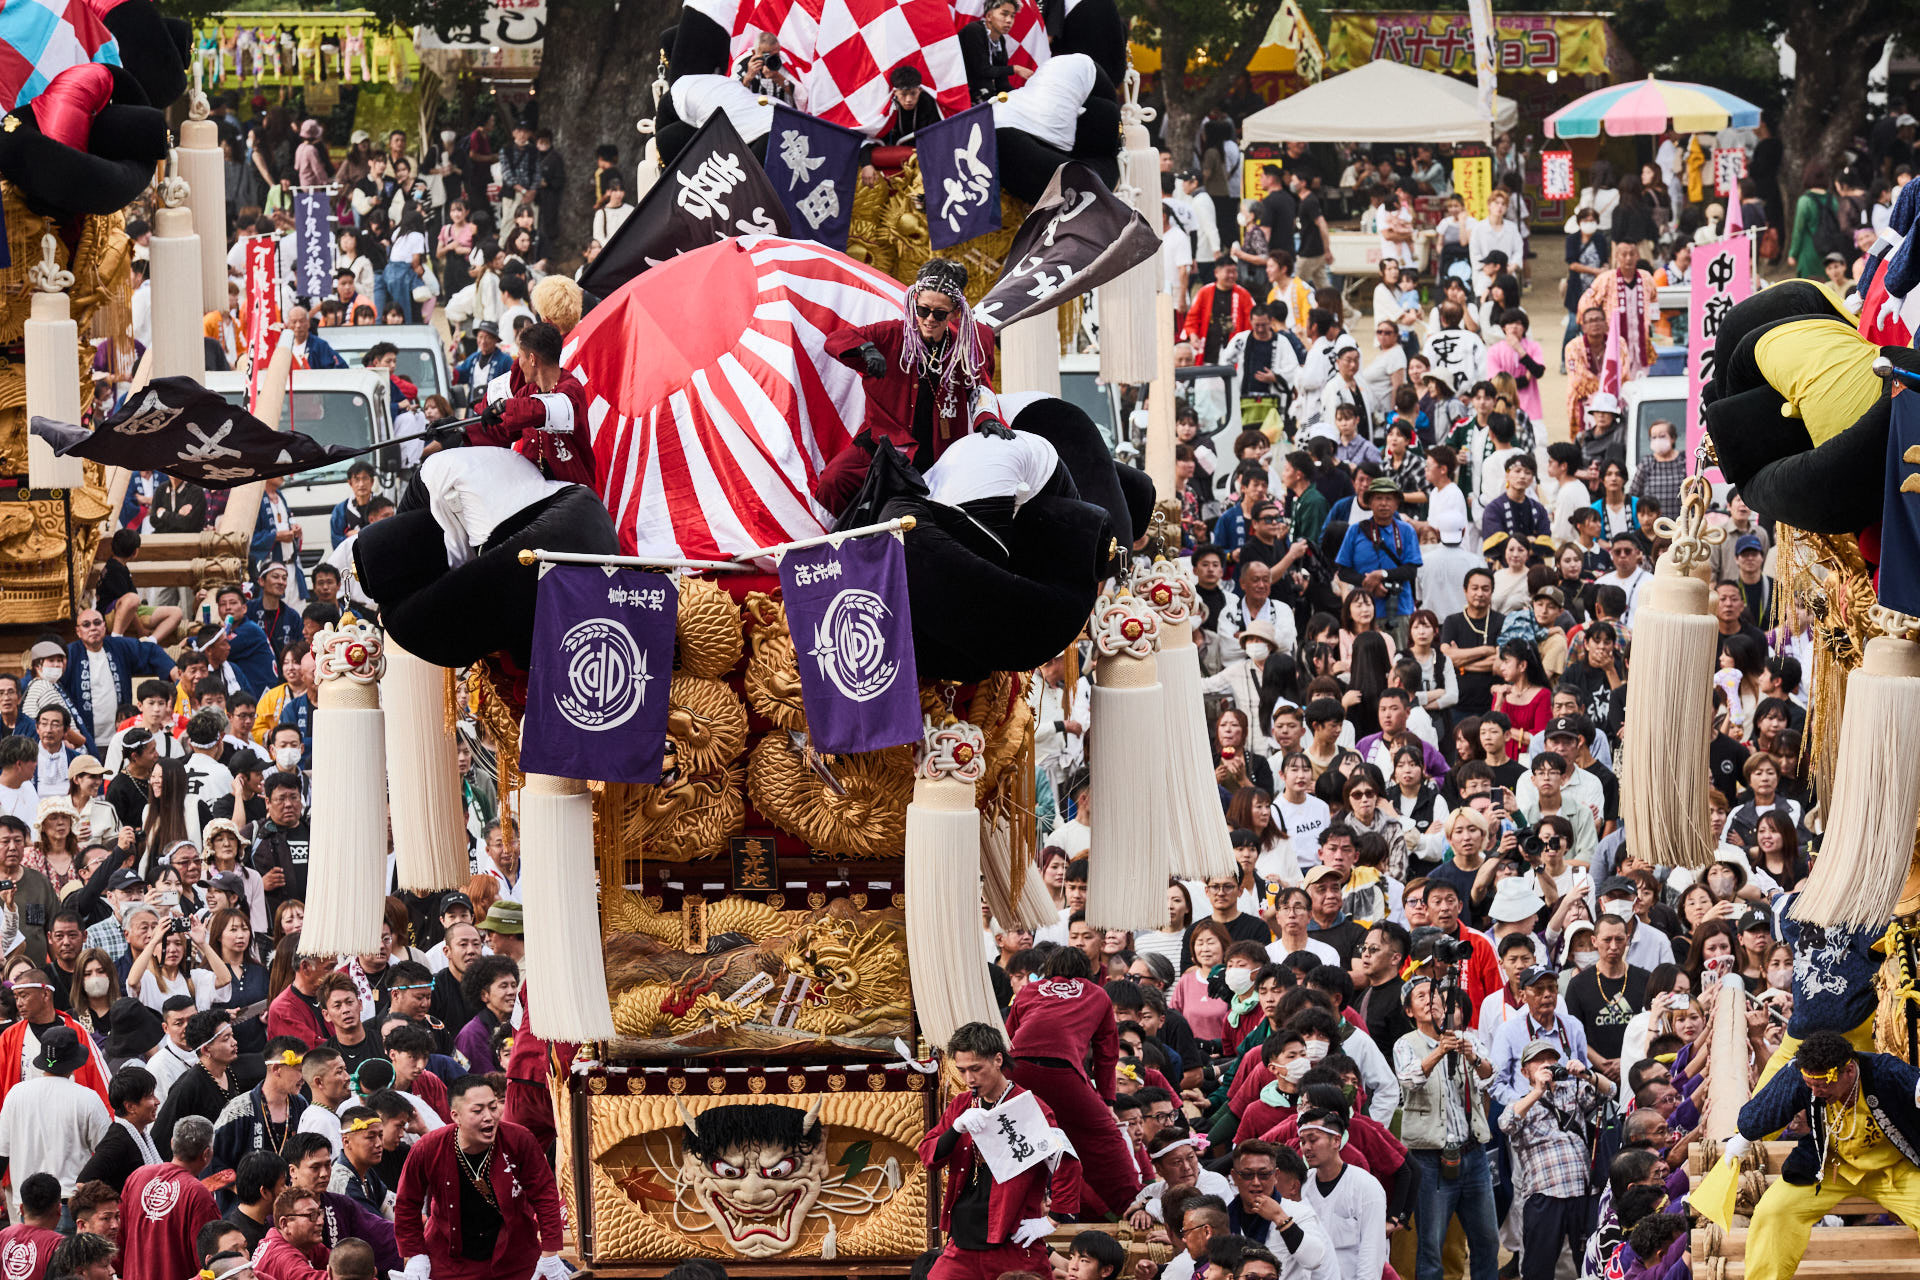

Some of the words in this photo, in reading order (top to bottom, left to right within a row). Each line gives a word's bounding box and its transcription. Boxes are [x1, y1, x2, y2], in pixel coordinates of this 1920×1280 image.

[1372, 26, 1560, 68] バナナョコ
[780, 129, 839, 229] 東田
[794, 558, 842, 587] 喜光地
[608, 585, 666, 612] 喜光地
[1296, 820, 1322, 834] ANAP
[738, 839, 770, 888] 喜光地
[1595, 1011, 1633, 1026] adida
[996, 1114, 1035, 1162] 喜光地
